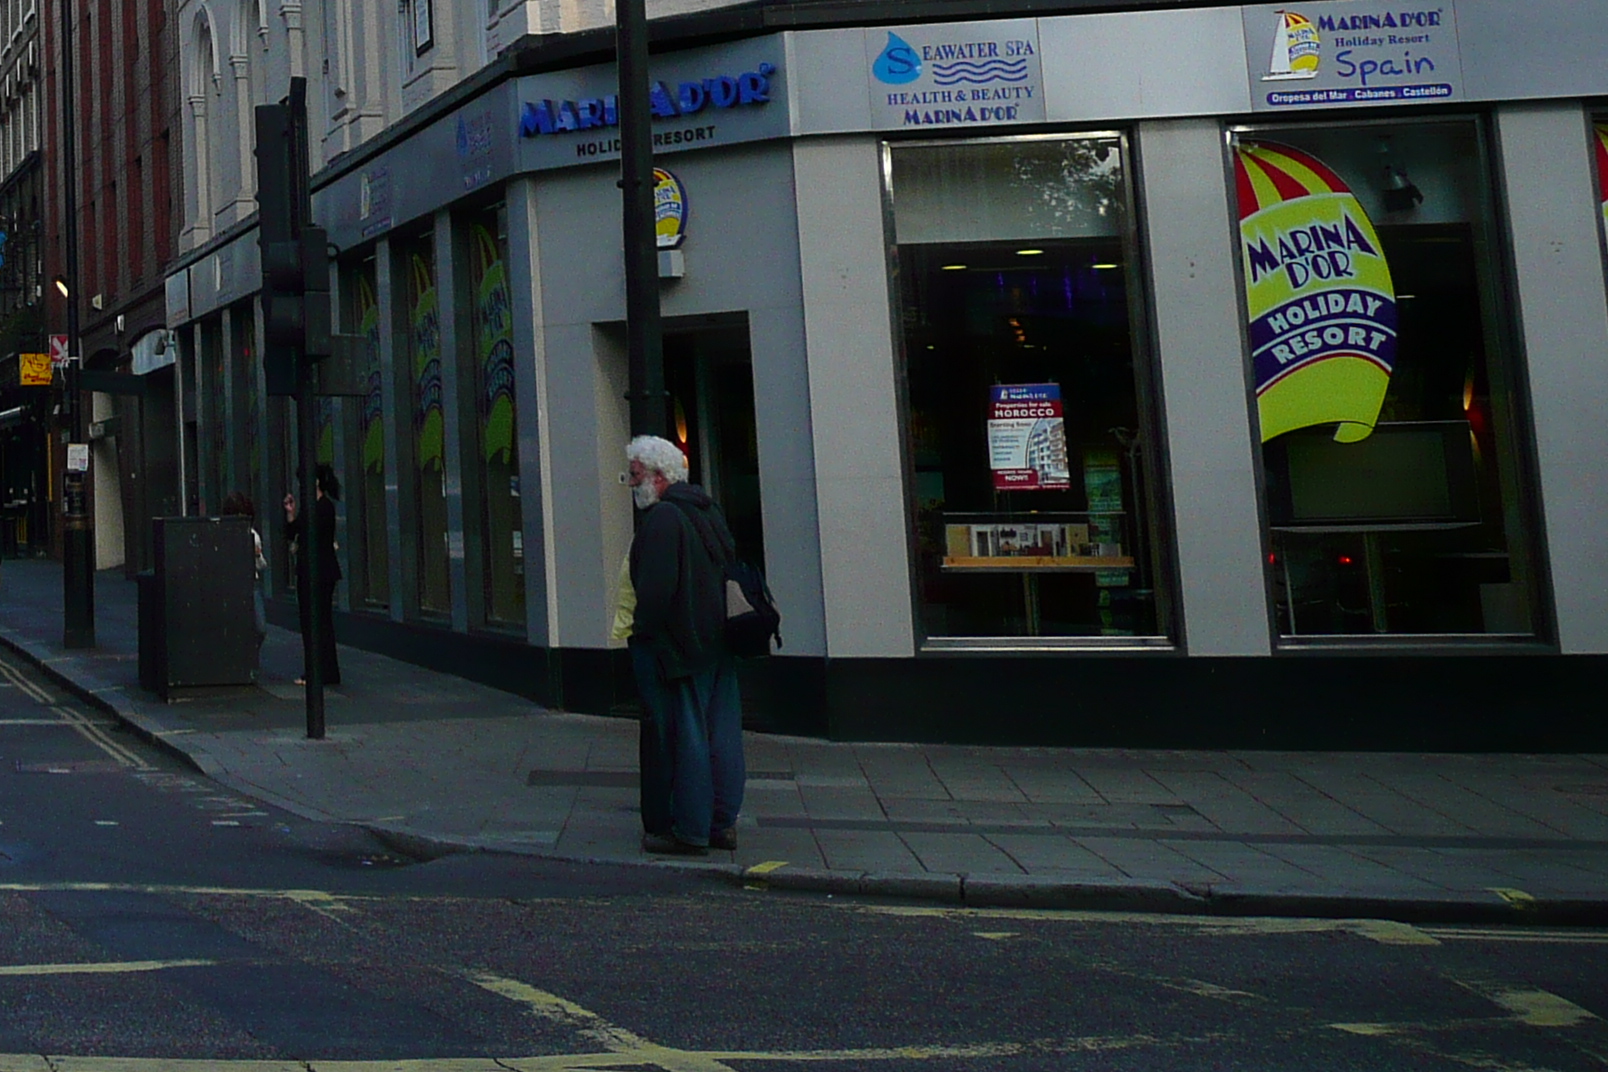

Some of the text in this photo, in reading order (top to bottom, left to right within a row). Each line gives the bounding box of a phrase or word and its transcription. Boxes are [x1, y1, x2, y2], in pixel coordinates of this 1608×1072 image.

[1317, 11, 1441, 32] MARINA D'OR
[1005, 40, 1035, 56] SPA
[1335, 34, 1430, 48] Holiday Resort
[1336, 50, 1435, 86] Spain
[519, 81, 678, 138] MARIA
[679, 72, 770, 114] D'OR
[887, 86, 1035, 106] HEALTH & BEAUTY
[1271, 86, 1448, 104] Oropesa del Mar Cabanes Castellón
[903, 105, 1018, 125] MARINA D'OR
[653, 126, 716, 146] RESORT
[1247, 213, 1379, 283] MARINA
[1285, 251, 1354, 289] D'OR
[1267, 293, 1383, 334] HOLIDAY
[1271, 327, 1387, 364] RESORT
[994, 408, 1055, 417] MOROCCO
